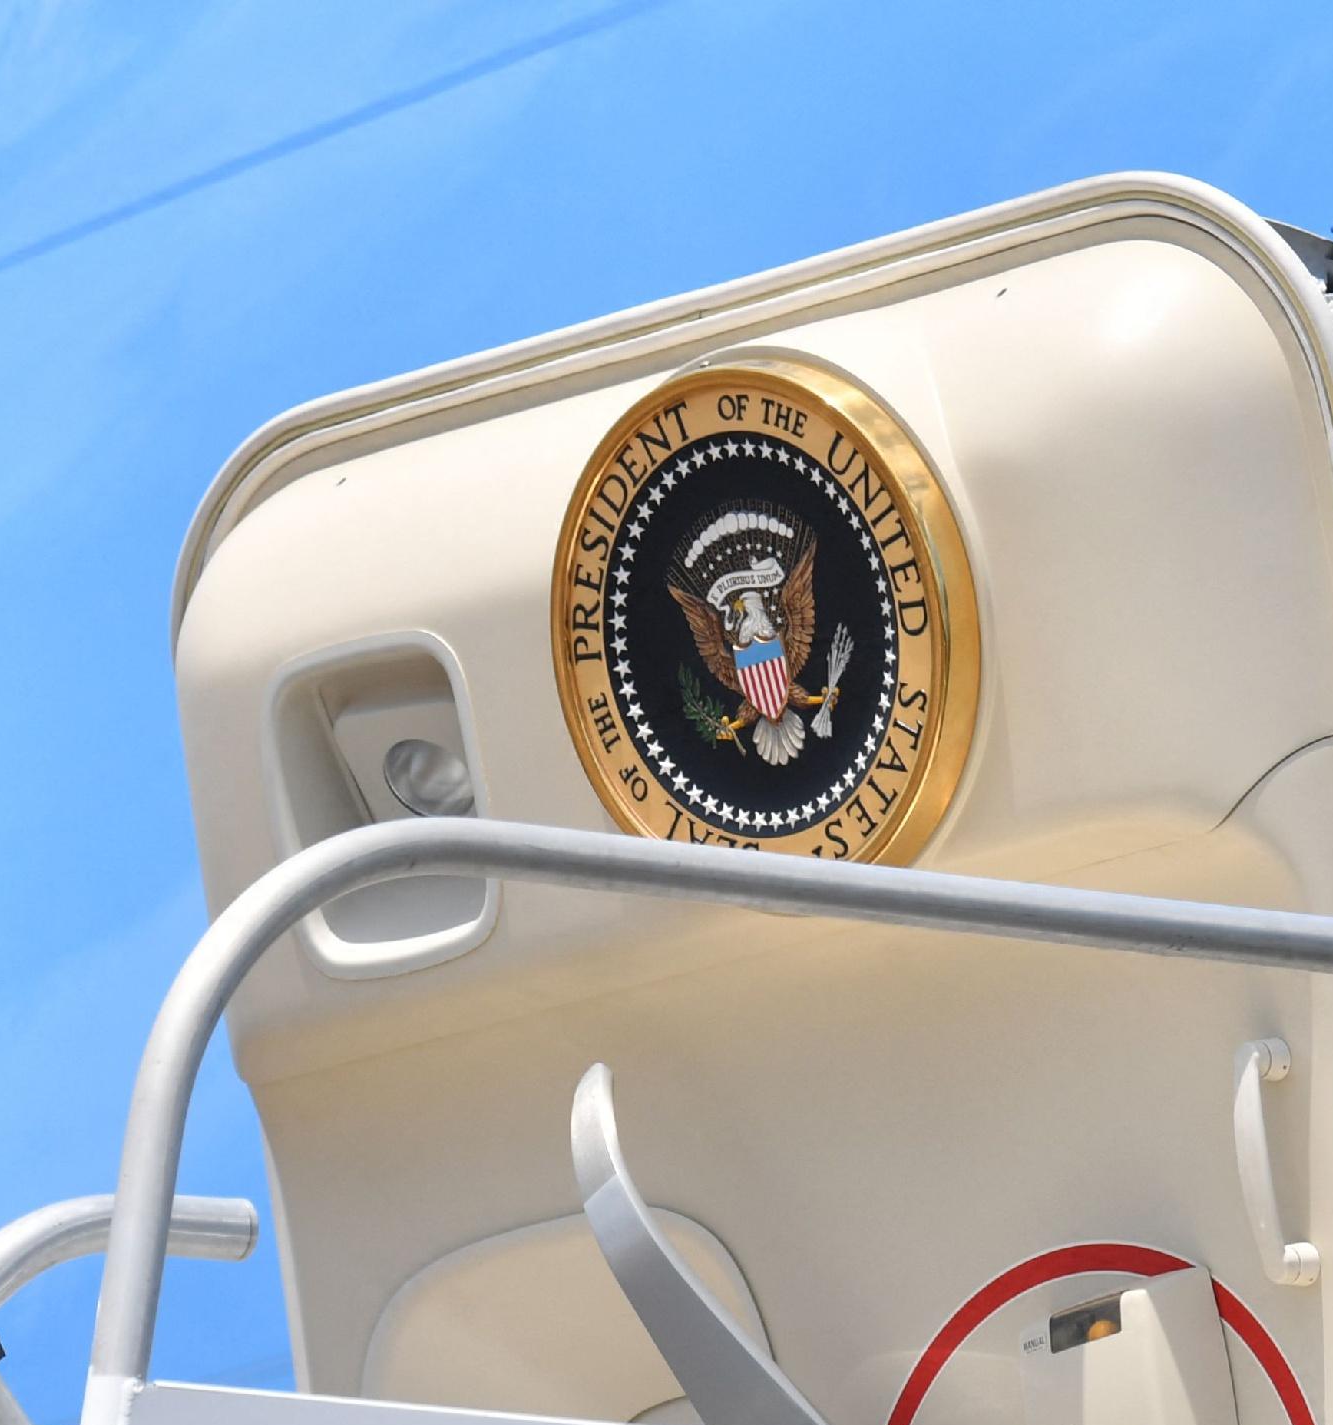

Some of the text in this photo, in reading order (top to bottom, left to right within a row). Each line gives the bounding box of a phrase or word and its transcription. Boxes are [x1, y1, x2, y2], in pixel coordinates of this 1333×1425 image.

[717, 394, 750, 421] OF
[761, 397, 808, 439] THE
[572, 402, 689, 665] PRESIDENT
[827, 430, 928, 637] UNITED
[588, 692, 621, 754] THE
[619, 764, 649, 802] OF
